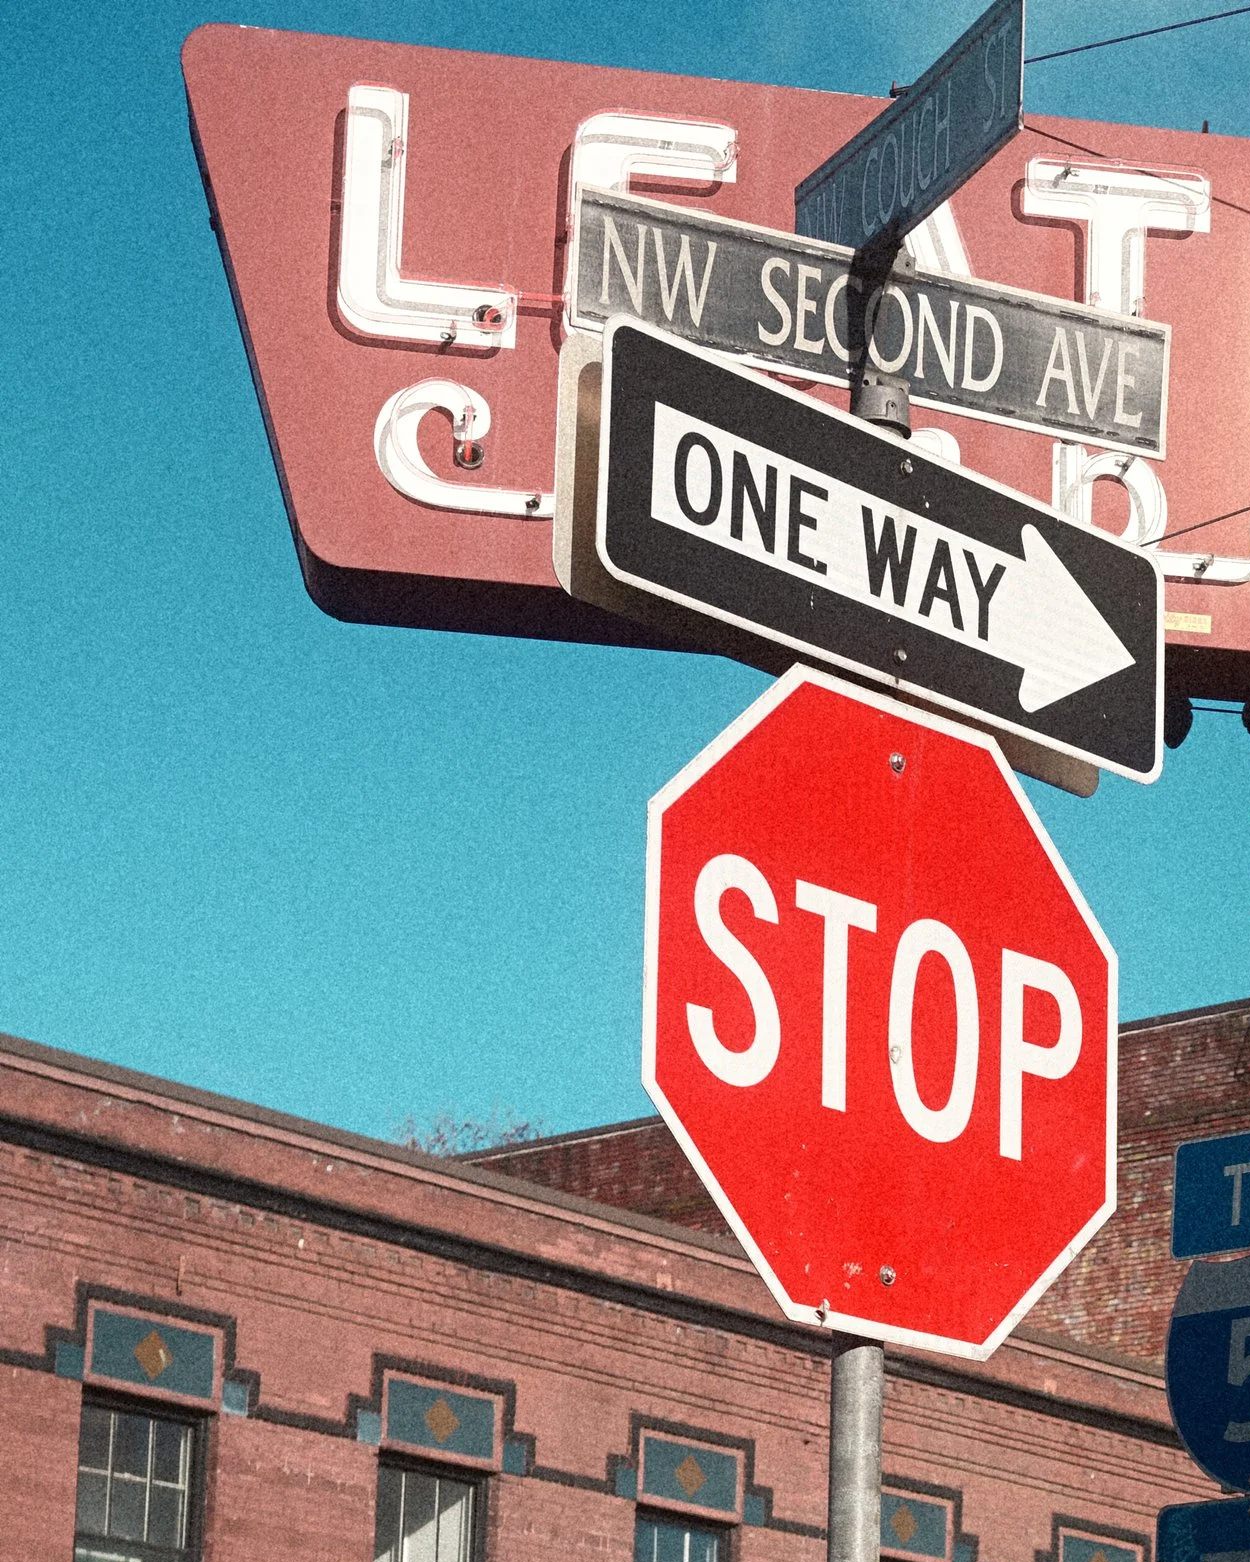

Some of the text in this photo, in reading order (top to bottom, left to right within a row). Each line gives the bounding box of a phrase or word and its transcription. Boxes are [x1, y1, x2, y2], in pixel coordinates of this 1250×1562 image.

[862, 80, 950, 236] COUCH
[983, 19, 1012, 133] ST
[600, 215, 1143, 428] NW SECOND AVE
[673, 432, 1007, 642] ONE WAY
[686, 853, 1084, 1161] STOP
